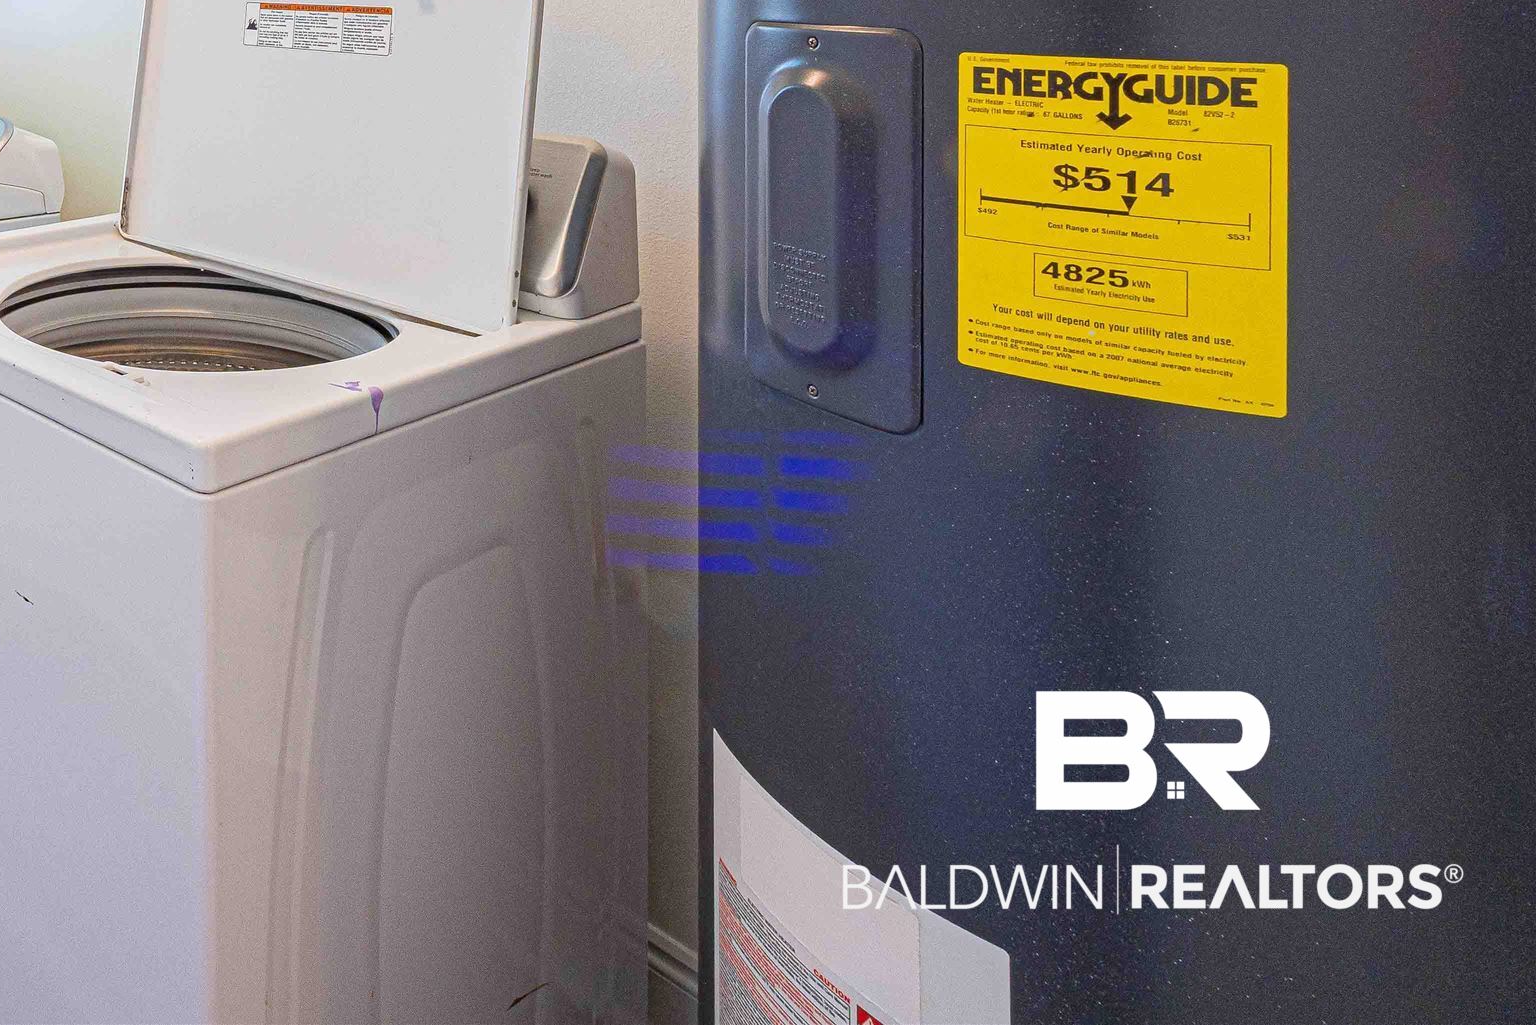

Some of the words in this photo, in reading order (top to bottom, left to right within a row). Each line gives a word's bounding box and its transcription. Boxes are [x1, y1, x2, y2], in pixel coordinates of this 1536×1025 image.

[1065, 59, 1086, 67] Federal
[1171, 63, 1186, 71] label
[972, 65, 1259, 110] ENERGYGUIDE
[967, 105, 989, 115] Capacity
[1052, 111, 1083, 120] GALLONS
[1014, 99, 1044, 108] ELECTRIC
[1167, 108, 1189, 116] Model
[1020, 139, 1073, 153] Estimated
[1077, 144, 1112, 157] Yearly
[1116, 147, 1172, 161] Operating
[1176, 151, 1203, 162] Cost
[1052, 163, 1176, 198] $514
[977, 206, 999, 216] $492
[1047, 221, 1064, 230] Cost
[1065, 223, 1090, 234] Range
[1101, 227, 1128, 237] Similar
[1130, 231, 1160, 240] Models
[1041, 260, 1130, 289] 4825
[1131, 279, 1152, 289] kWh
[1053, 283, 1085, 295] Estimated
[1086, 288, 1107, 298] Yearly
[1108, 291, 1141, 303] Electricity
[1142, 295, 1156, 304] Use
[992, 303, 1013, 315] Your
[1015, 307, 1034, 319] cost
[1036, 310, 1053, 321] will
[1055, 314, 1091, 328] depend
[1093, 320, 1106, 330] on
[1108, 321, 1130, 333] your
[1132, 326, 1161, 339] utility
[1164, 330, 1189, 342] rates
[1191, 334, 1211, 345] and
[1213, 337, 1235, 347] use.
[975, 318, 990, 327] Cost
[991, 322, 1011, 331] range
[1013, 325, 1035, 335] based
[1036, 330, 1052, 339] only
[1065, 334, 1093, 345] models
[1104, 341, 1131, 350] similar
[1133, 345, 1165, 356] capacity
[1167, 349, 1193, 359] fueled
[1194, 353, 1205, 362] by
[975, 337, 990, 345] cost
[1020, 345, 1040, 354] cents
[1041, 349, 1054, 357] per
[975, 330, 1008, 342] Estimated
[1010, 337, 1044, 349] operating
[1045, 344, 1062, 352] cost
[1062, 346, 1086, 356] based
[1105, 353, 1125, 362] 2007
[1126, 357, 1159, 367] national
[1160, 362, 1192, 372] average
[1194, 366, 1234, 378] electricity
[975, 347, 987, 356] For
[988, 351, 1006, 360] more
[1052, 363, 1069, 371] visit
[813, 968, 851, 1005] CAUTION
